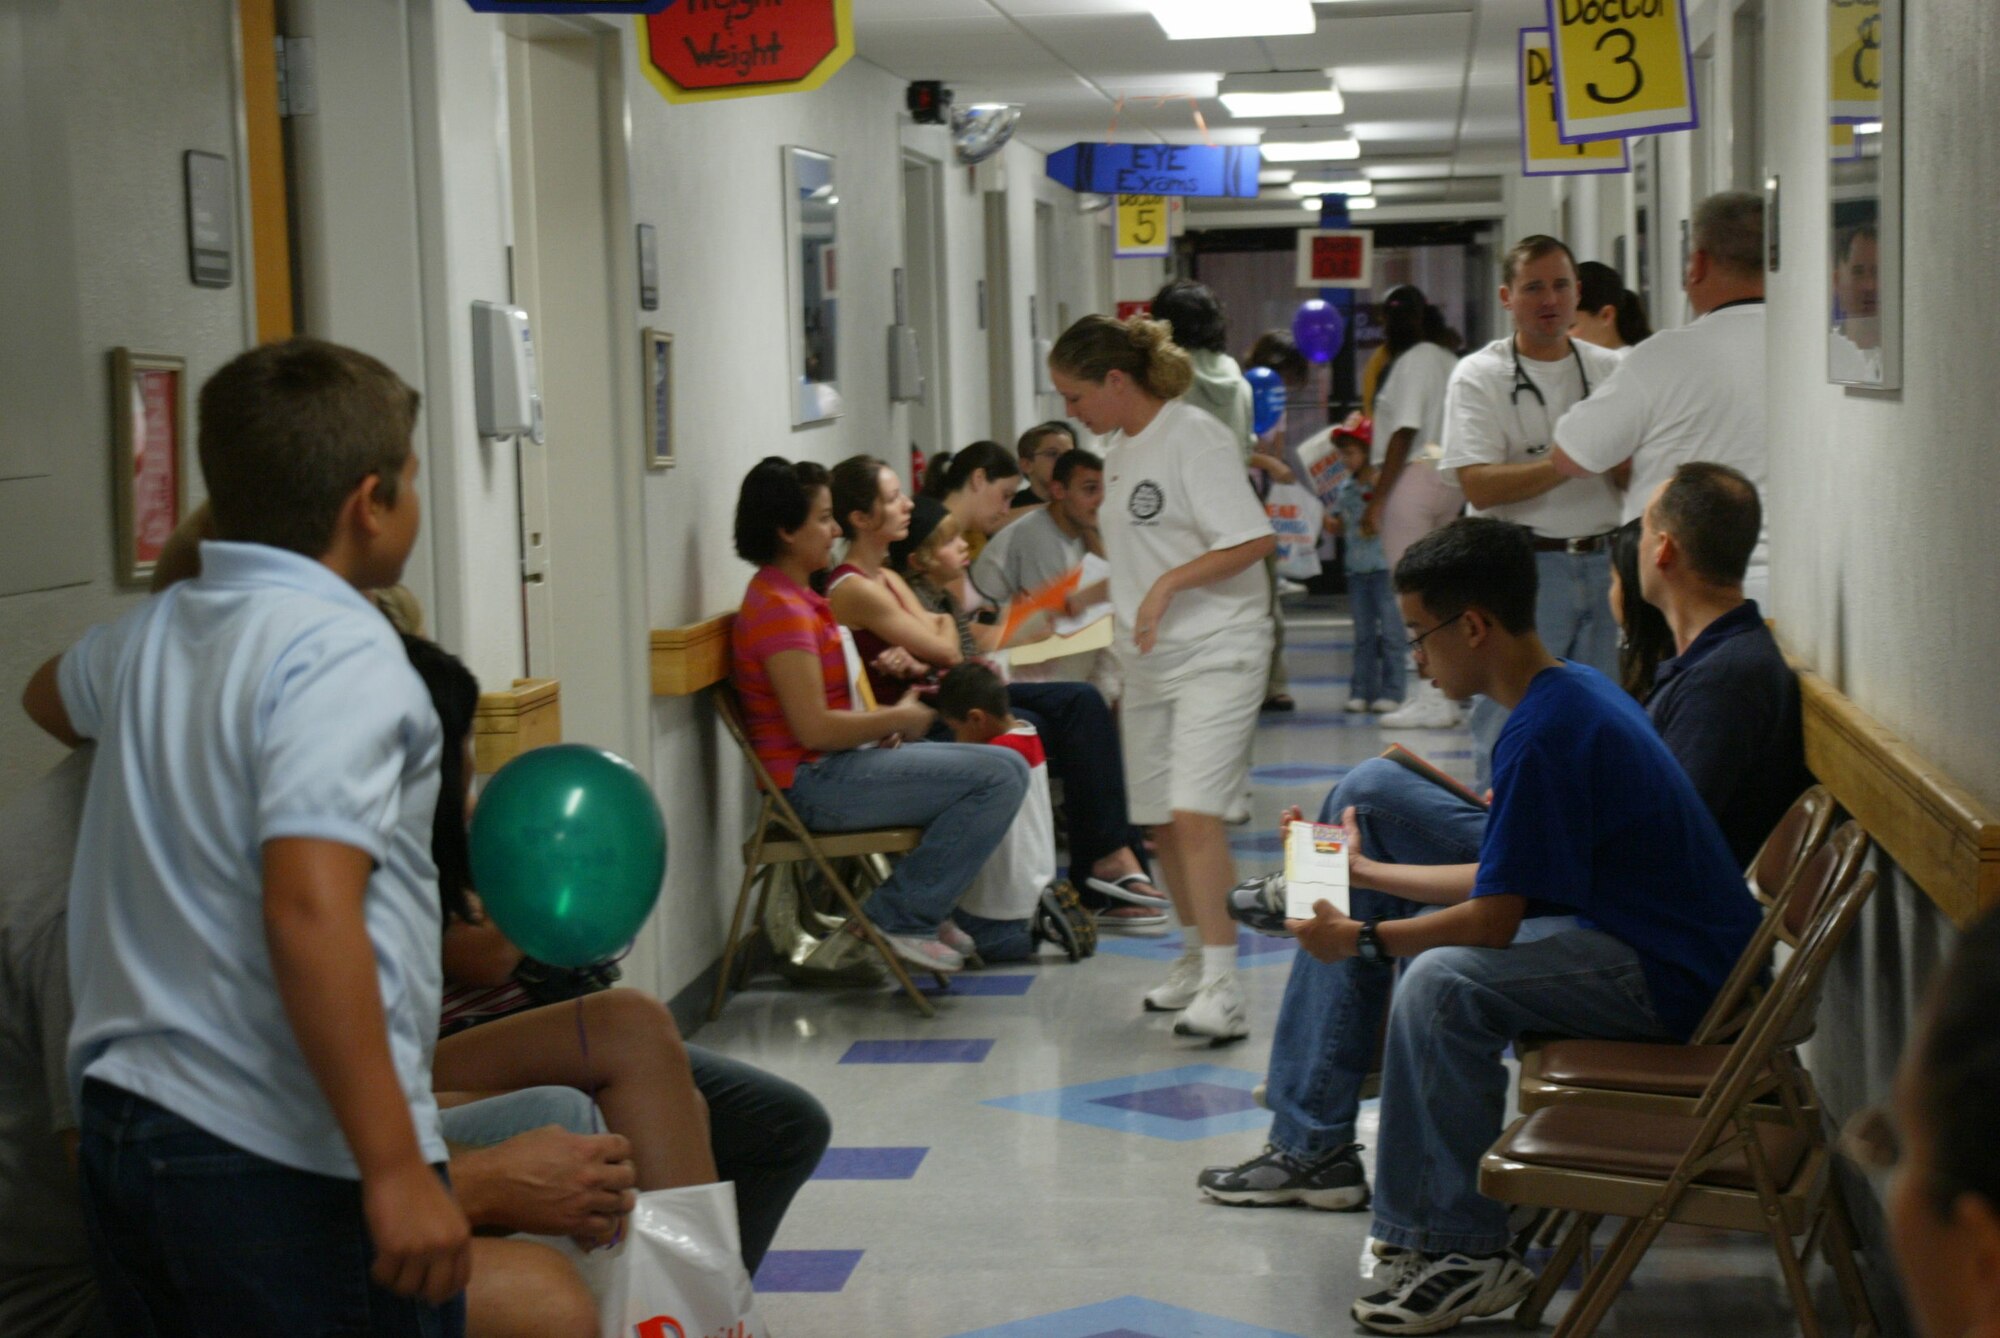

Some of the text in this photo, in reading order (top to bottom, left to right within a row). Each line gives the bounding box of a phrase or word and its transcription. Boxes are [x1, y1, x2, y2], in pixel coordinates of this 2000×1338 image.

[683, 31, 784, 77] Weight
[1586, 28, 1643, 104] 3
[1132, 144, 1189, 170] EYE
[1116, 168, 1199, 192] Exams
[1133, 209, 1156, 244] 5
